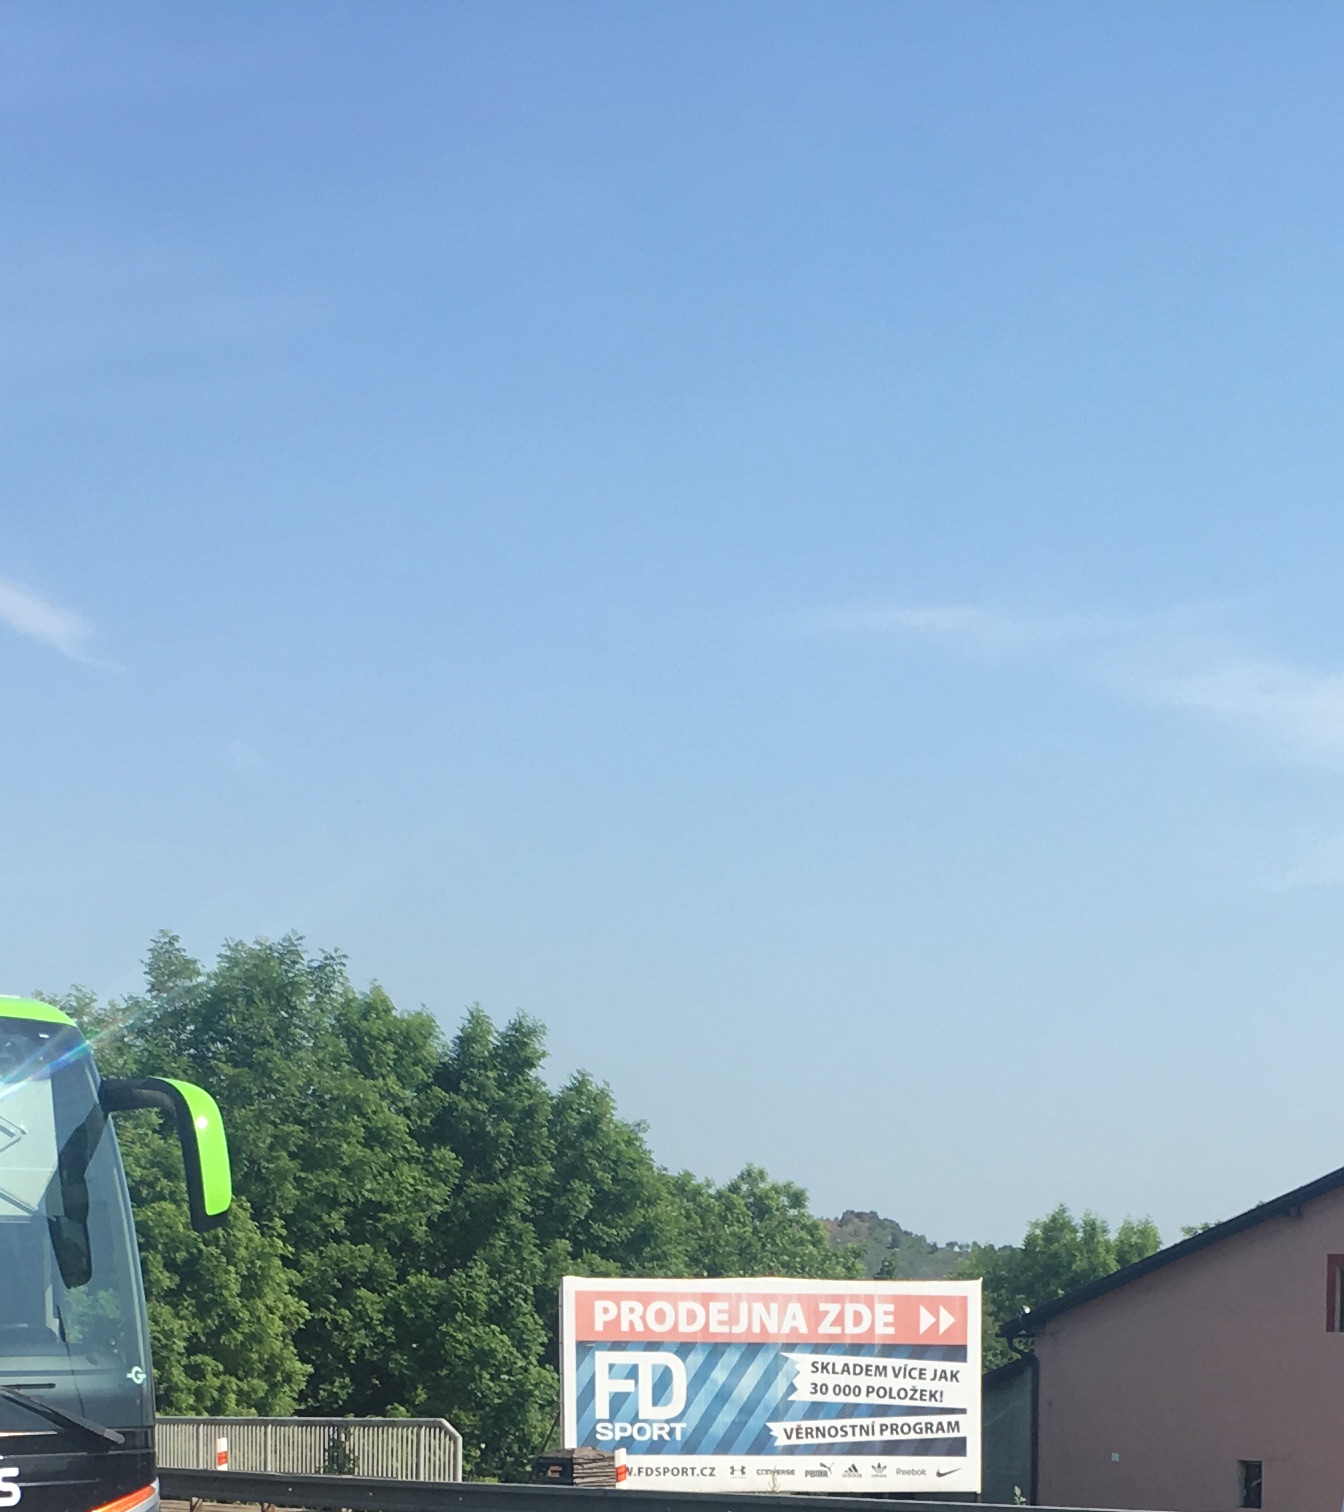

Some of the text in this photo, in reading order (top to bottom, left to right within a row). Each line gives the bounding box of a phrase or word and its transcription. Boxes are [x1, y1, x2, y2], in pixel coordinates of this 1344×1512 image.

[594, 1300, 896, 1335] PRODEJNA ZDE
[810, 1361, 961, 1383] SKLADEM VÍCE JAK
[595, 1351, 687, 1420] FD
[810, 1382, 944, 1403] 30 000 POLOŽEK!
[595, 1422, 688, 1441] SPORT
[783, 1420, 961, 1441] VĚRNOSTNÍ PROGRAM
[895, 1468, 927, 1476] Reebok
